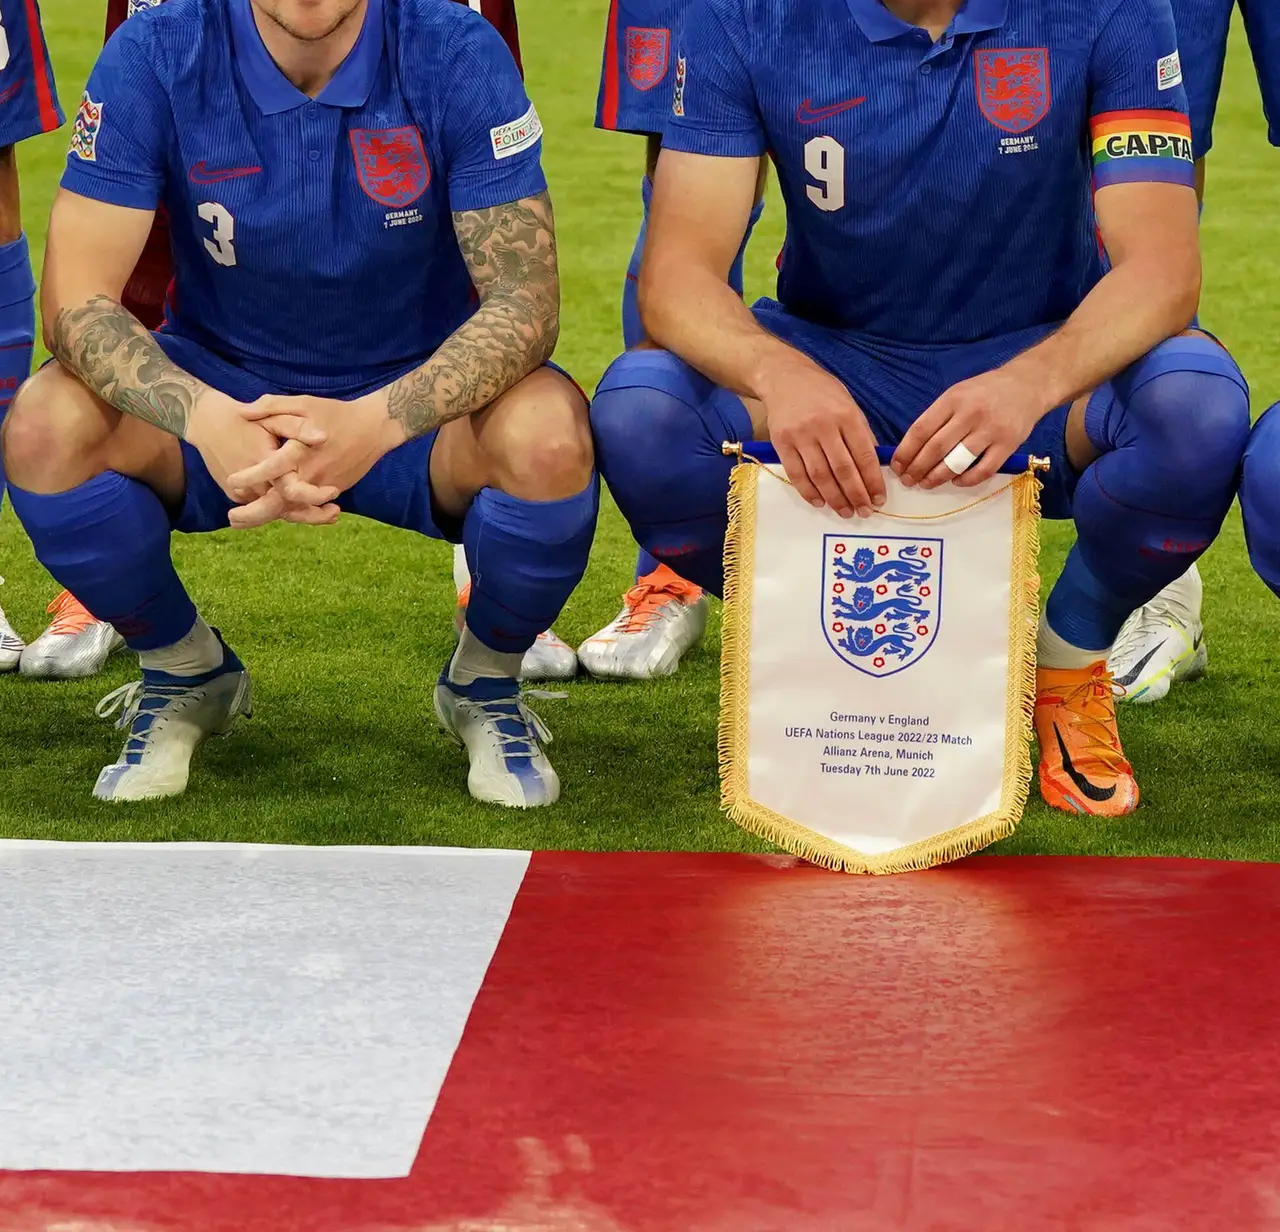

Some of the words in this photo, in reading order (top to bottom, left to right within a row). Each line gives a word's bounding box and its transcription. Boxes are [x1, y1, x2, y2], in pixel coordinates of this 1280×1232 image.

[1000, 136, 1034, 146] GERMANY
[1106, 134, 1192, 161] CAPTA
[1004, 145, 1022, 154] JUNE
[804, 136, 845, 212] 9
[385, 209, 419, 220] GERMANY
[389, 218, 407, 227] JUNE
[197, 201, 238, 267] 3
[829, 711, 877, 726] Germany
[879, 716, 886, 724] v
[888, 714, 930, 728] England
[784, 727, 813, 739] UEFA
[815, 728, 855, 740] Nations
[858, 730, 895, 743] League
[897, 732, 939, 743] 2022/23
[941, 733, 973, 746] Match
[822, 746, 858, 757] Allianz
[859, 747, 893, 760] Arena,
[896, 749, 934, 761] Munich
[820, 762, 862, 777] Tuesday
[864, 764, 881, 775] 7th
[883, 766, 909, 777] June
[911, 767, 936, 778] 2022
